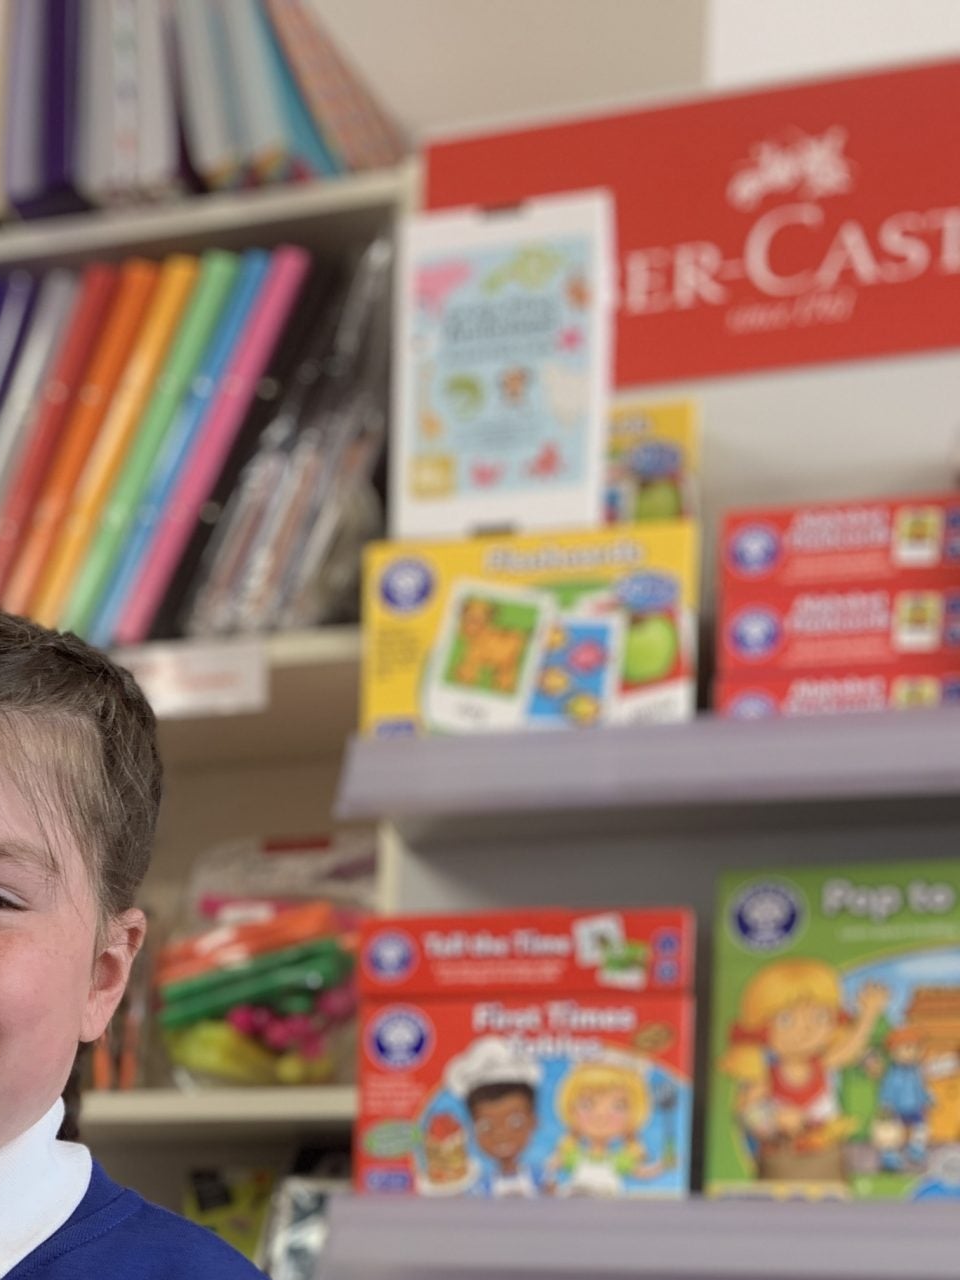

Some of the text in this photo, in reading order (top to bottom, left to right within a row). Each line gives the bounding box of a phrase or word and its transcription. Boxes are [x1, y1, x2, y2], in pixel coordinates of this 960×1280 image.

[617, 202, 960, 315] ER-CAST
[823, 880, 902, 922] Pop
[909, 881, 954, 912] to
[423, 933, 465, 958] Tell
[470, 933, 508, 957] the
[513, 929, 569, 957] Time
[472, 1002, 636, 1030] First Times
